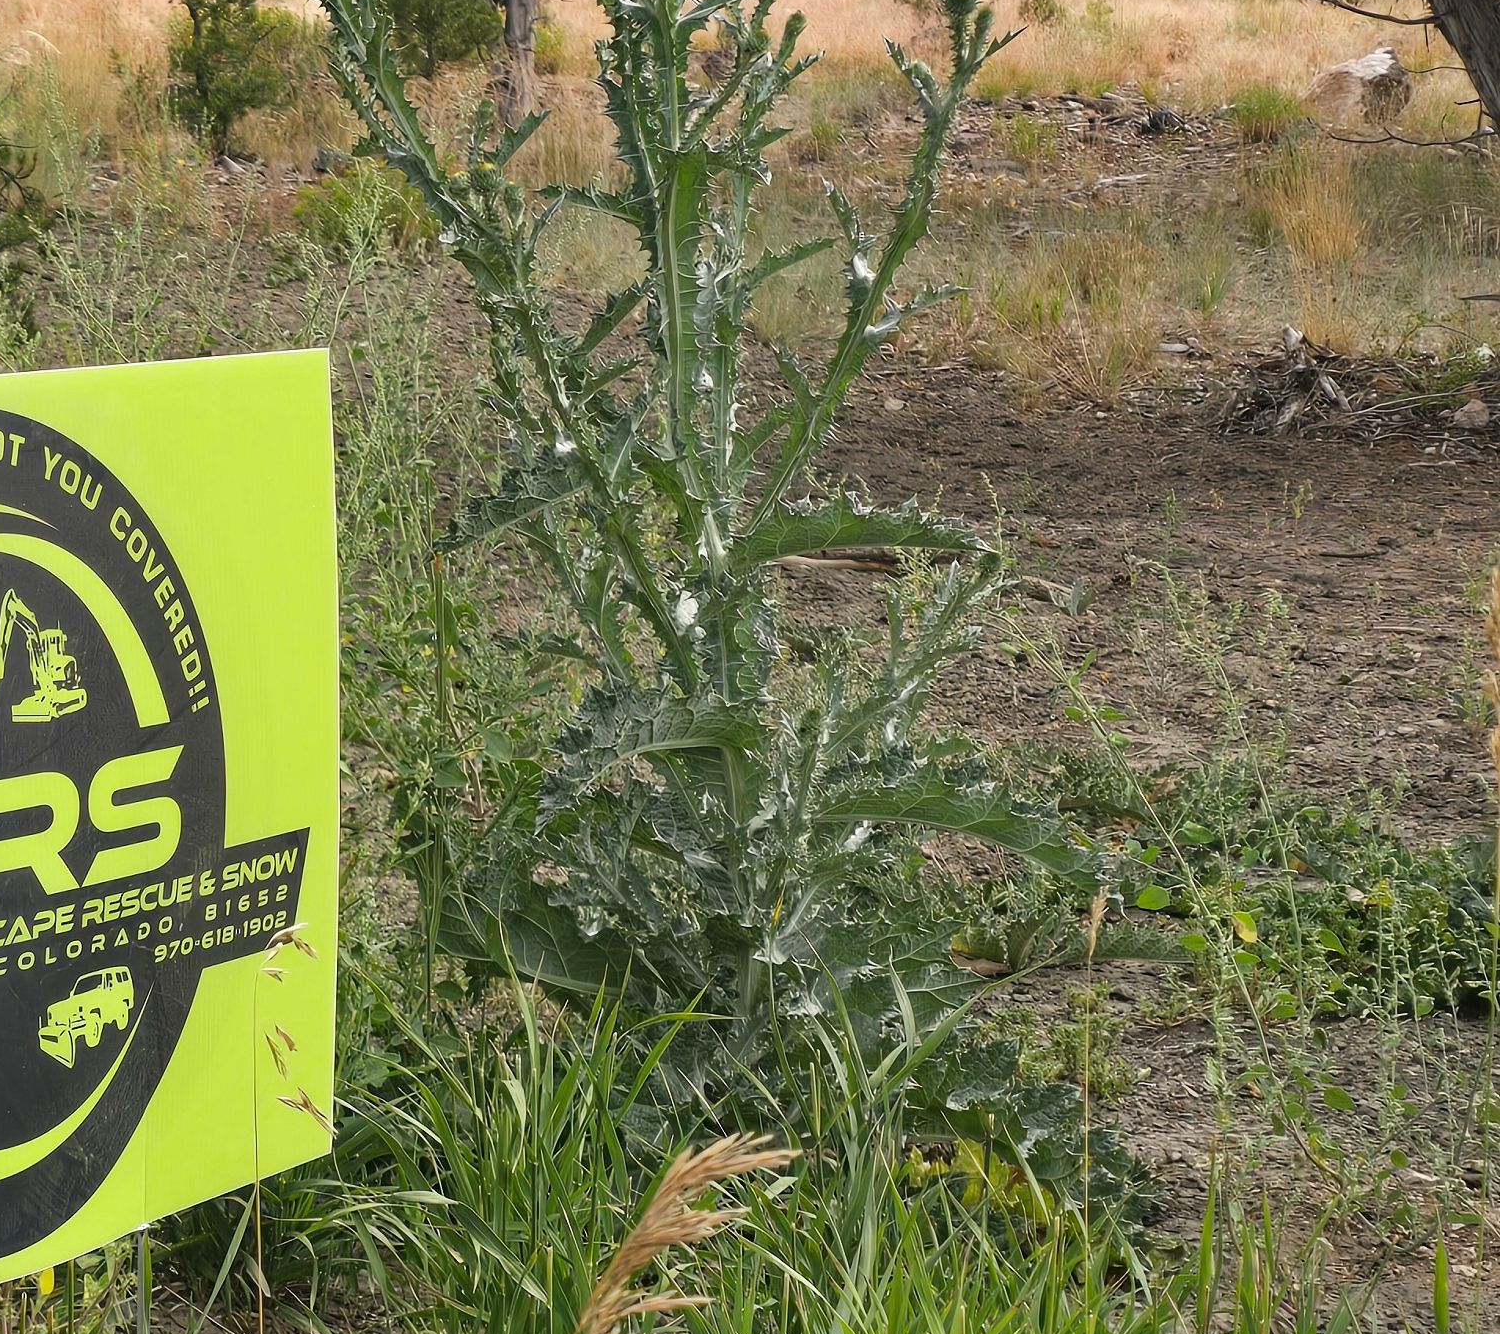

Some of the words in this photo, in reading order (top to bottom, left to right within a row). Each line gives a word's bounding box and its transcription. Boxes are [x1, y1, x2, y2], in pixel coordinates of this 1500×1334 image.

[43, 446, 103, 511] YOU
[109, 506, 210, 714] COVERED!!
[80, 874, 194, 928] RESCUE
[198, 869, 217, 897] &
[221, 846, 299, 892] SNOW
[204, 883, 289, 922] 81652
[153, 909, 288, 964] 970-618-1902
